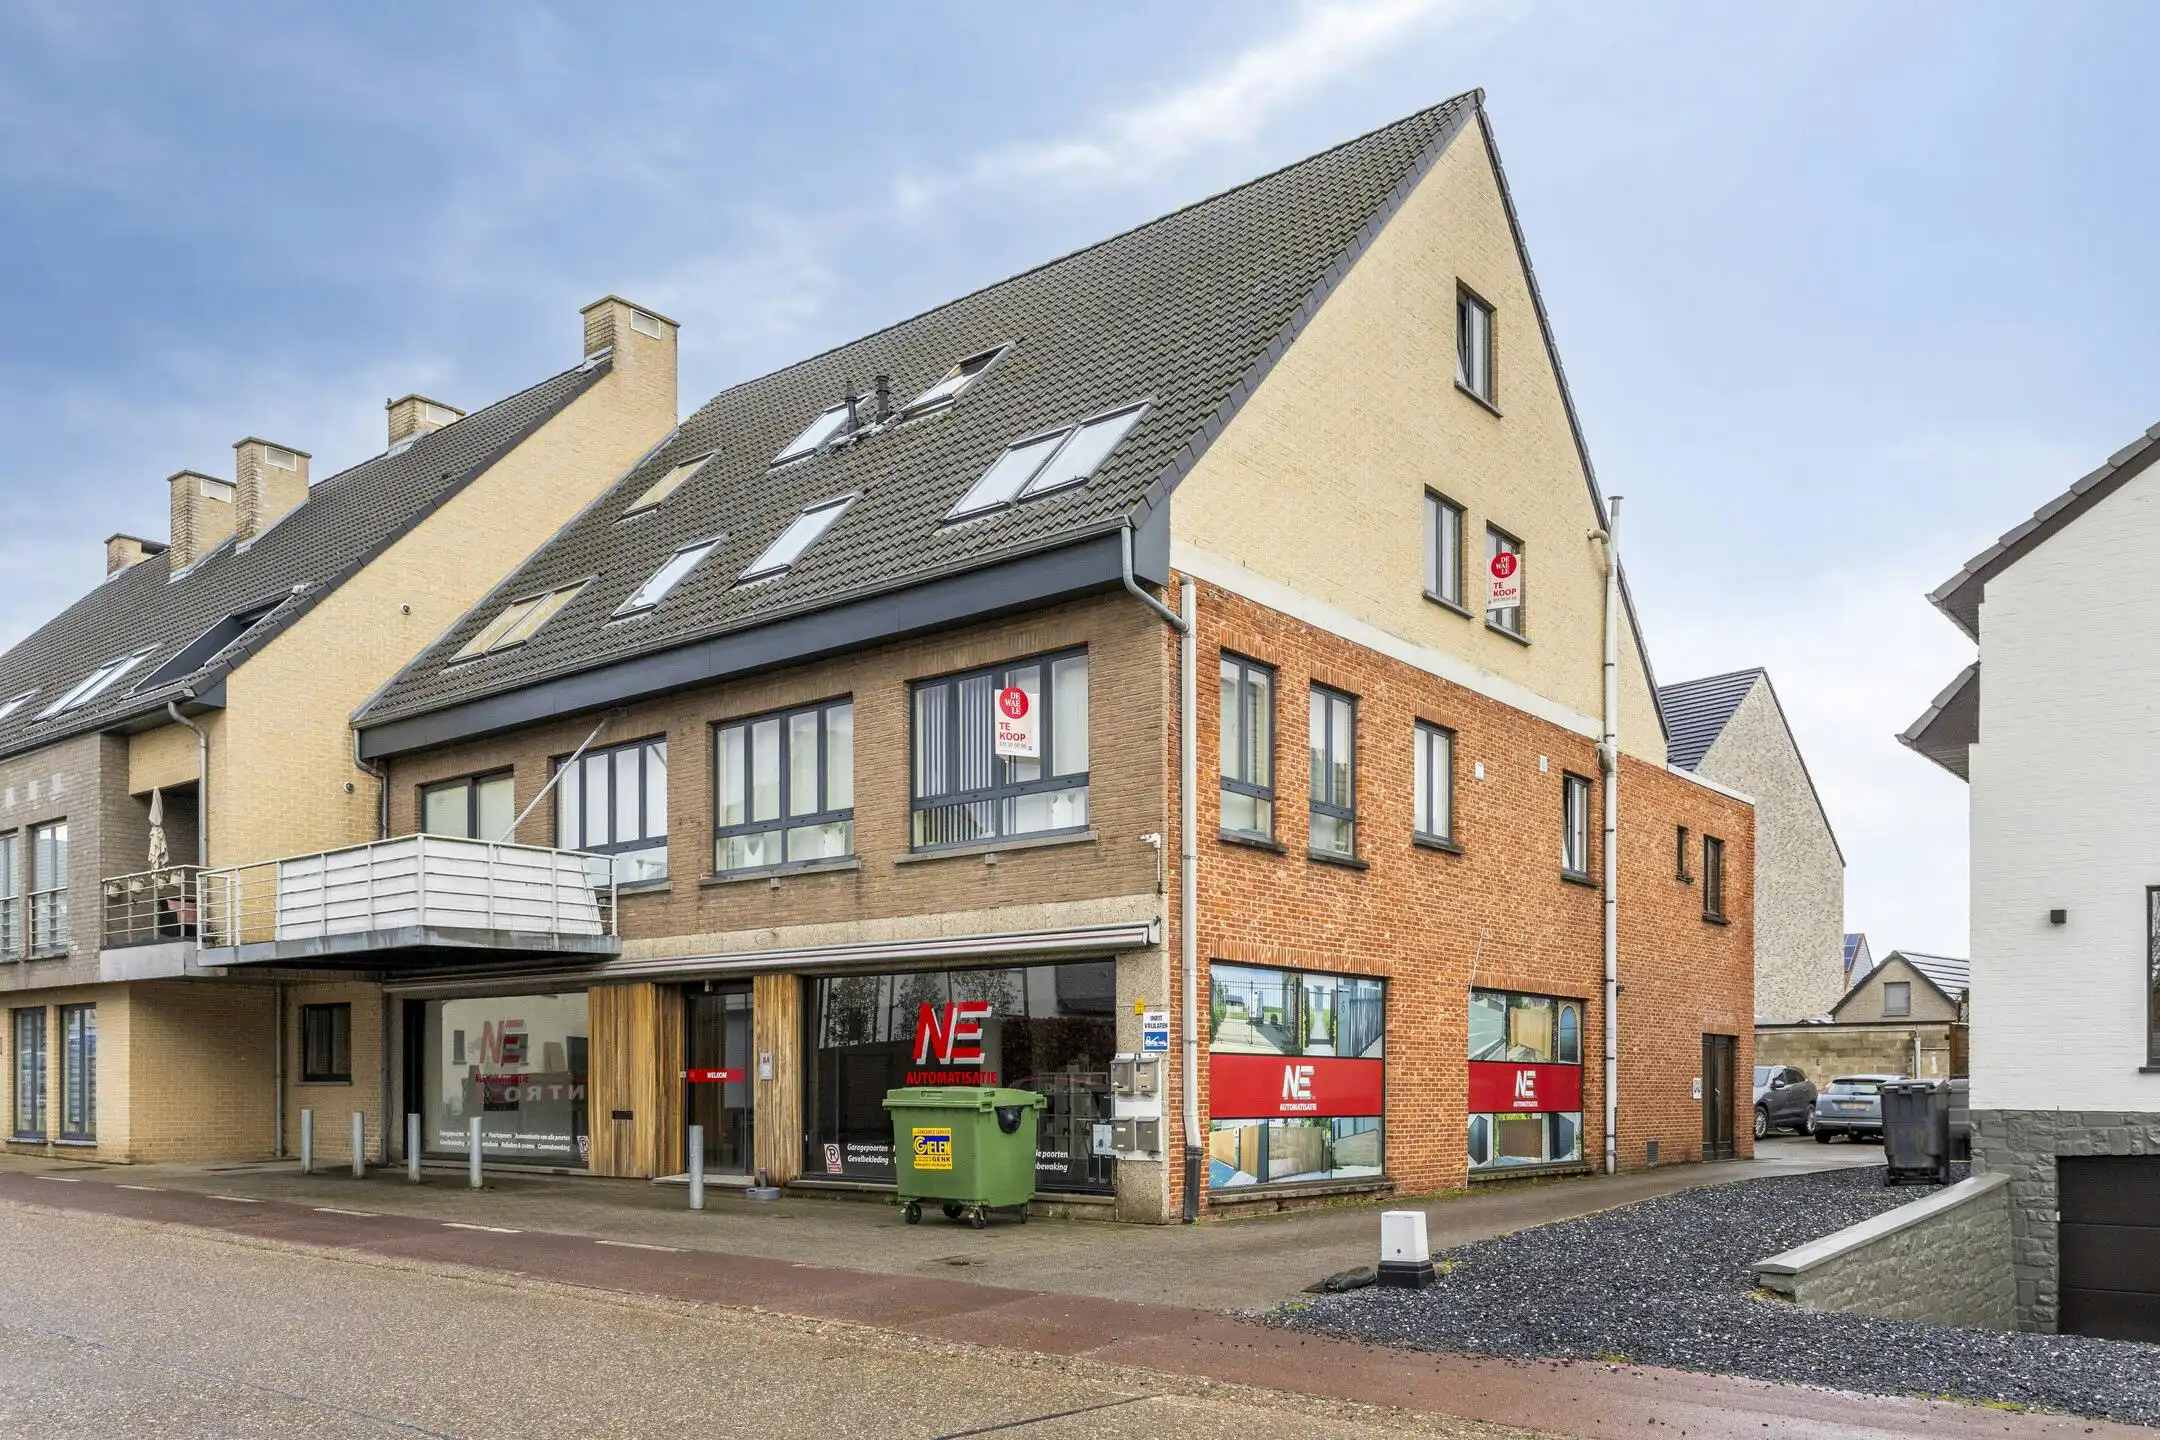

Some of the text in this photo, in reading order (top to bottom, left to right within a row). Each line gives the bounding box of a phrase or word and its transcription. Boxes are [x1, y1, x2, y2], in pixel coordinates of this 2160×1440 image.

[1494, 588, 1517, 597] KOOP
[1010, 692, 1020, 700] DE
[999, 722, 1010, 731] TE
[1000, 732, 1026, 741] KOOP
[912, 1001, 992, 1065] NE
[480, 1019, 525, 1064] NE
[906, 1071, 997, 1085] AUTOMATISATIE
[1282, 1065, 1315, 1100] NE
[1515, 1070, 1536, 1098] NE
[1280, 1103, 1317, 1111] AUTOMATISATIE
[847, 1144, 888, 1152] Garagepoorten
[914, 1136, 951, 1155] GIELEN
[1042, 1150, 1068, 1159] poorten
[848, 1155, 889, 1165] Gevelbekleding
